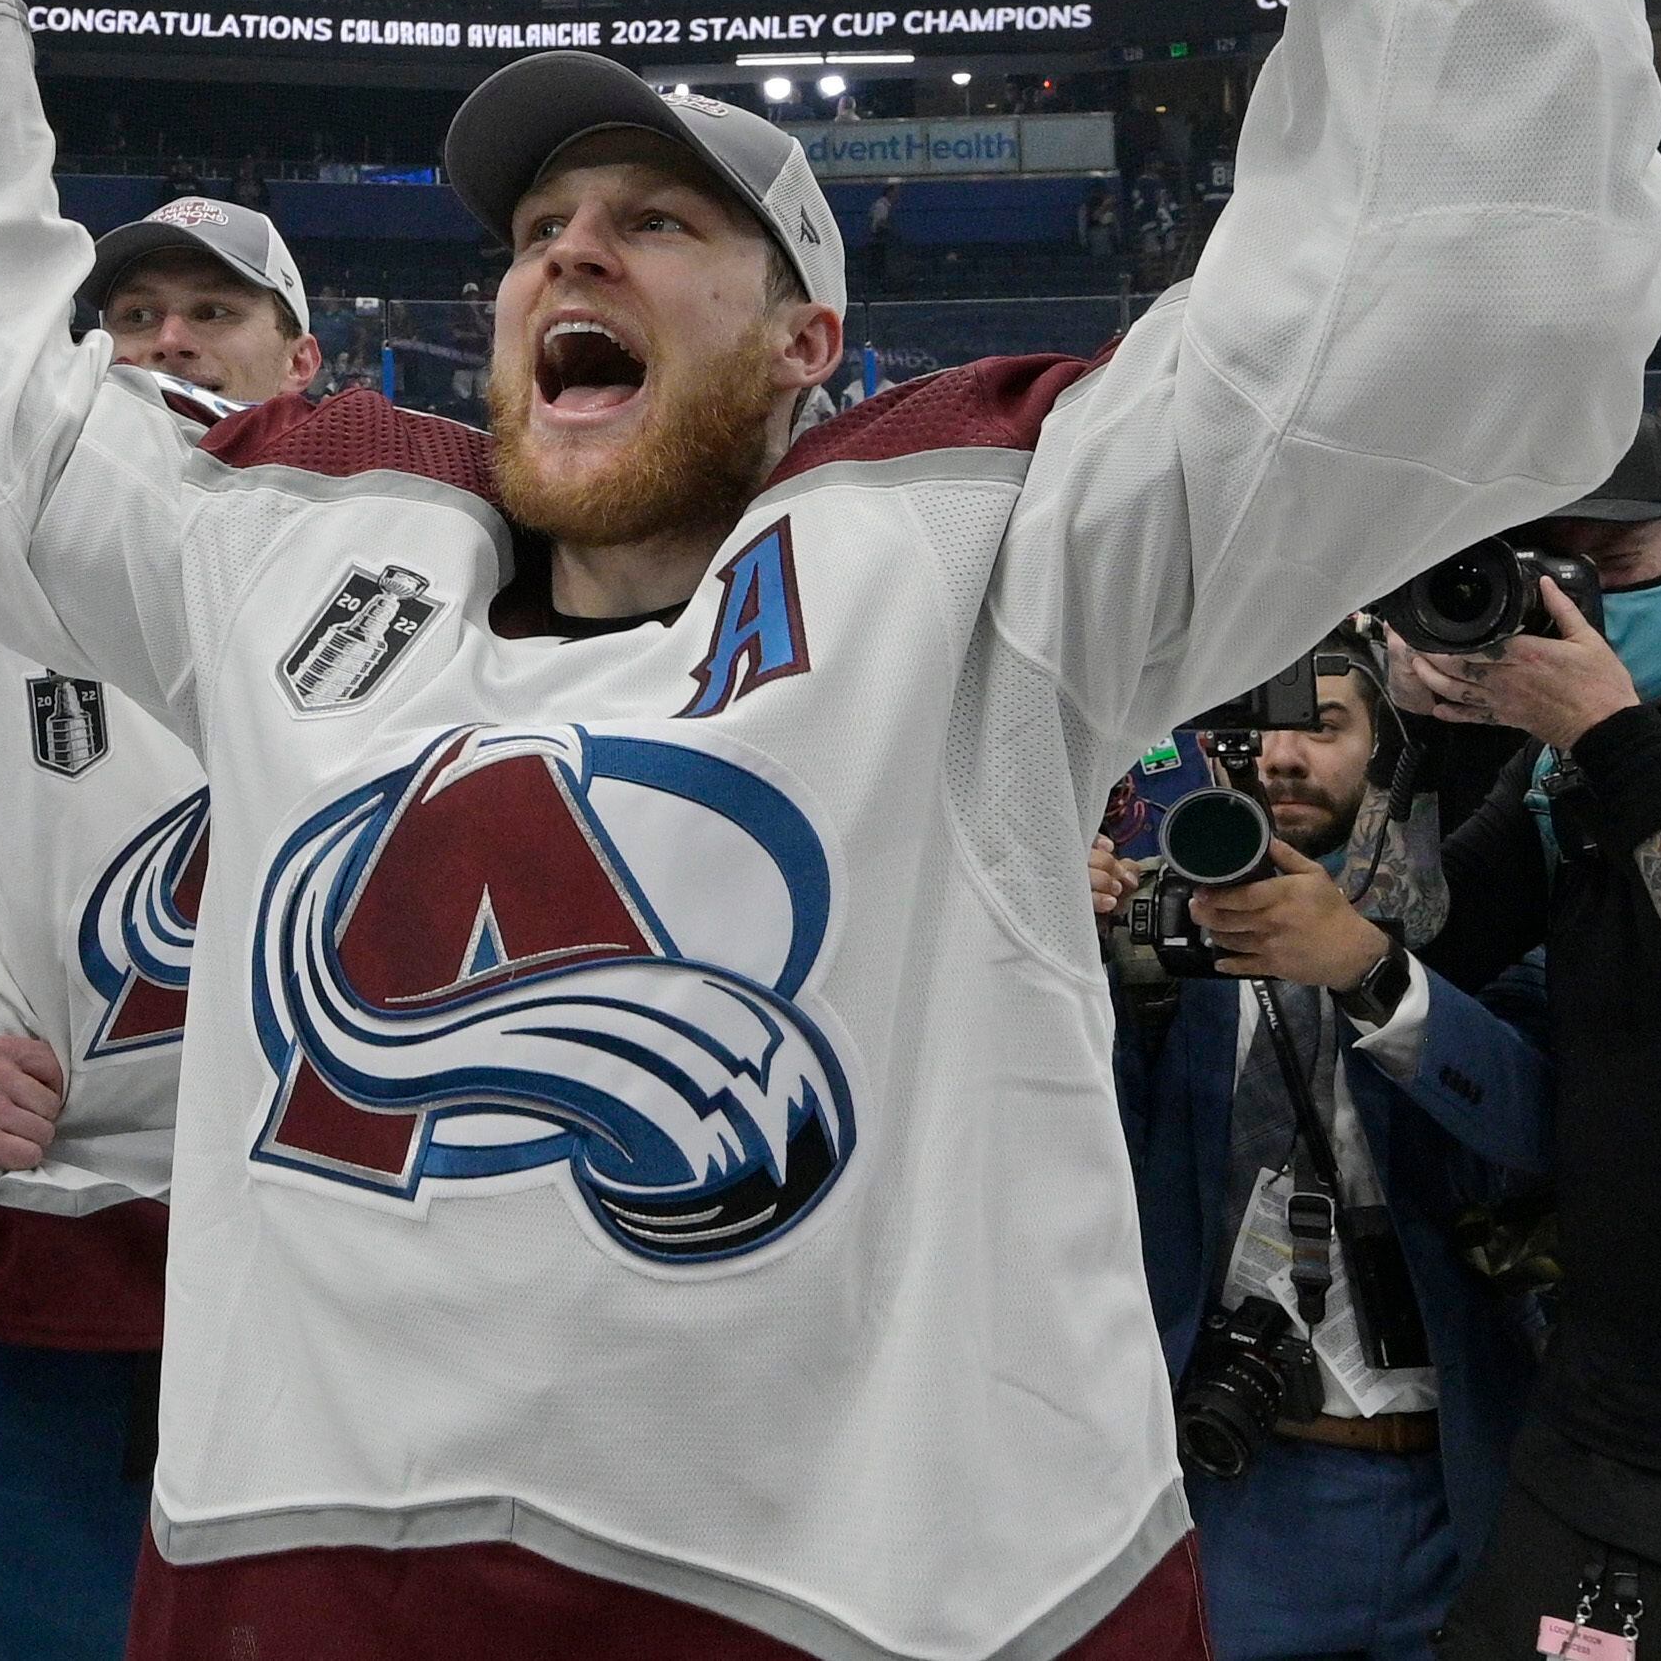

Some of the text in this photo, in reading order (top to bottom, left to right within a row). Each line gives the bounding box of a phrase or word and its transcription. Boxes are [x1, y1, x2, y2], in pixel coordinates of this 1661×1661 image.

[28, 3, 1091, 47] CONGRATULATIONS COLORADO AVALANCHE 2022 STANLEY CUP CHAMPIONS
[809, 130, 1017, 161] dventHealth
[336, 592, 360, 612] 20
[395, 616, 419, 636] 22
[37, 695, 52, 707] 20
[81, 689, 97, 702] 22
[1258, 990, 1280, 1030] FINAL
